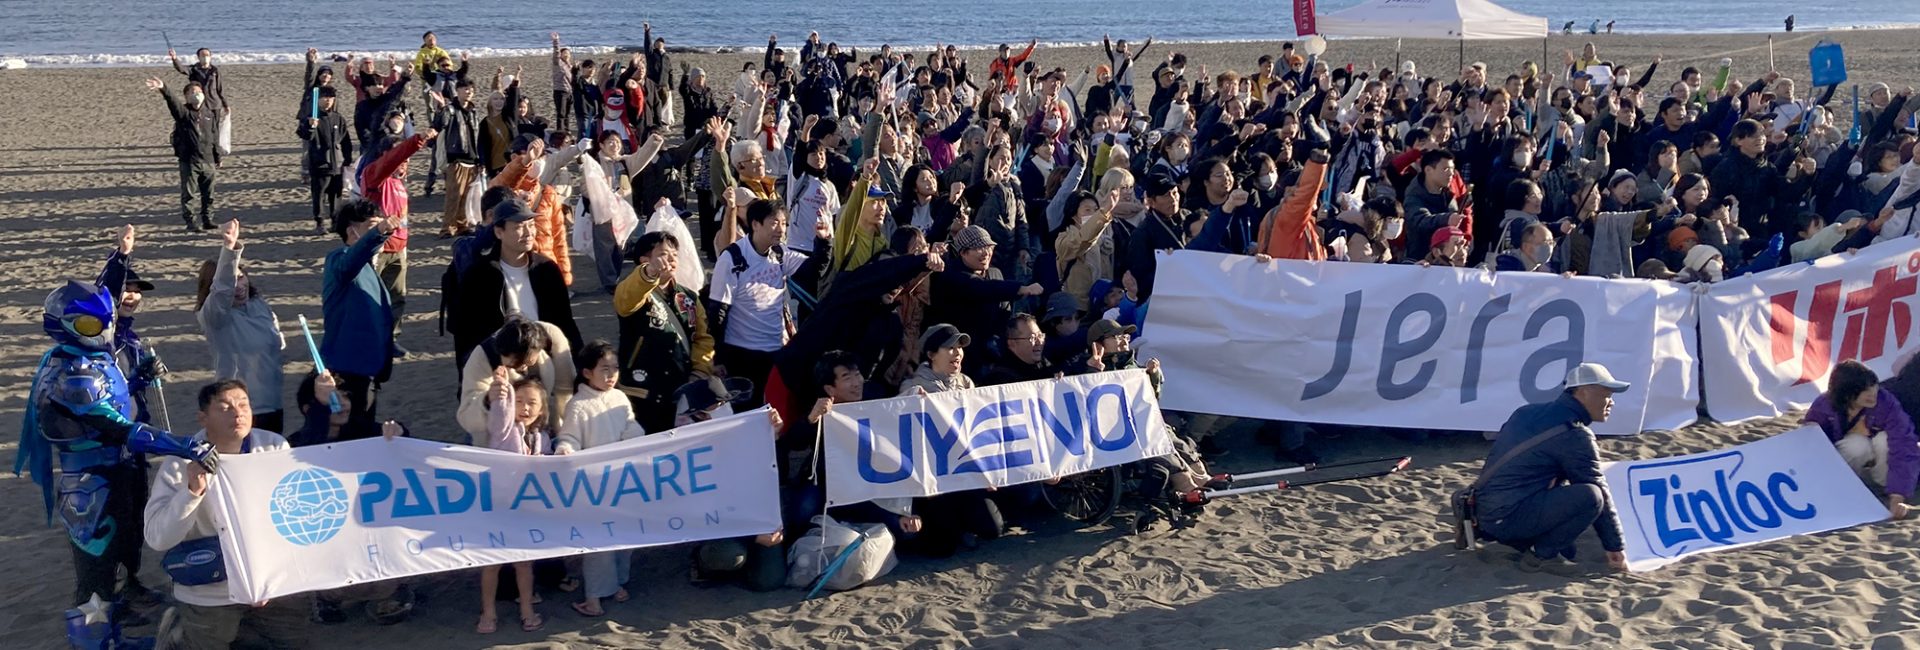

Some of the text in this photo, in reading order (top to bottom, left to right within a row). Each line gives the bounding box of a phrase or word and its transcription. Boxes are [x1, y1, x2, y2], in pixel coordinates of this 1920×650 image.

[857, 383, 1138, 484] UYENO
[357, 445, 718, 524] PADI AWARE
[367, 511, 721, 563] FOUNDATION
